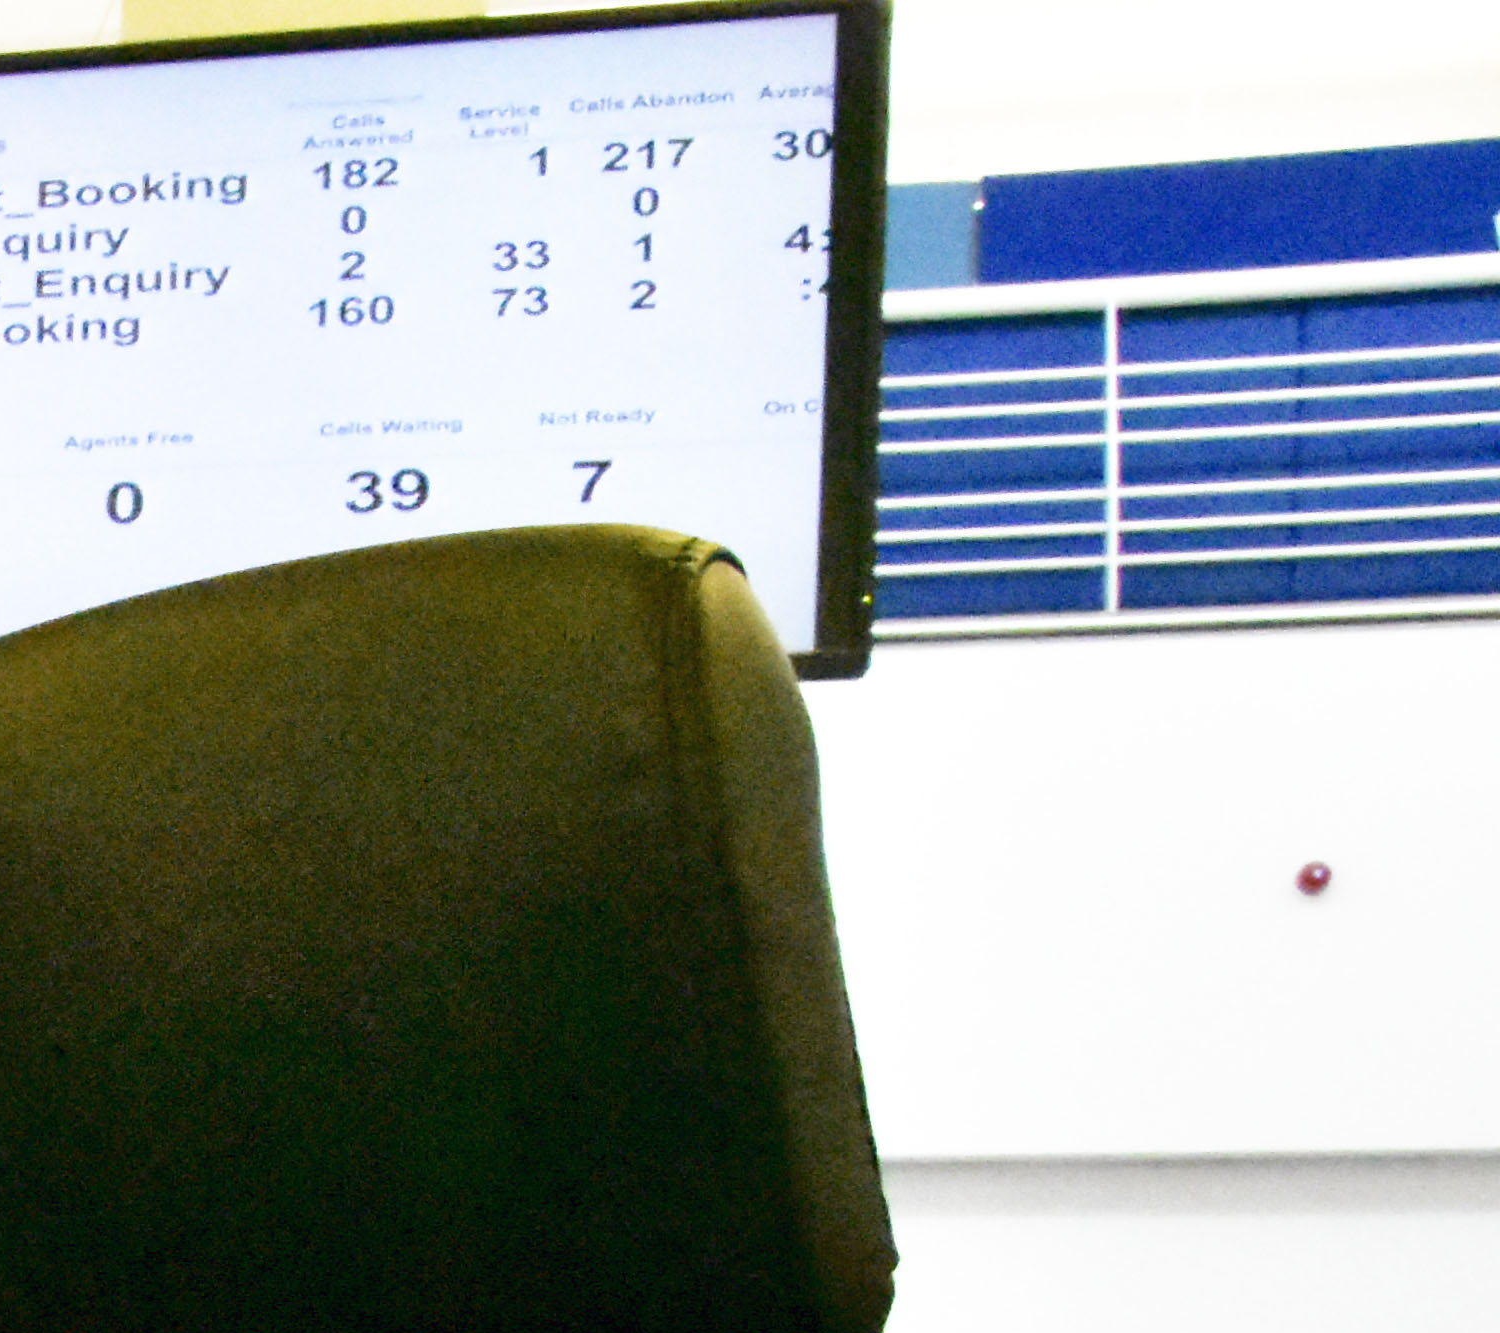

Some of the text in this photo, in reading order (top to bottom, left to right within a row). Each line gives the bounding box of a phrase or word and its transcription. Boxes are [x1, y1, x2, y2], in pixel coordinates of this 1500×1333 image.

[459, 102, 541, 122] Service
[569, 88, 735, 114] Calls Abandon
[469, 123, 530, 141] Level
[314, 157, 400, 191] 182
[530, 146, 551, 177] 1
[602, 137, 696, 174] 217
[340, 204, 367, 236] 0
[632, 186, 660, 218] 0
[340, 249, 367, 282] 2
[492, 240, 551, 273] 33
[633, 233, 654, 264] 1
[307, 295, 396, 328] 160
[492, 286, 551, 318] 73
[629, 279, 658, 312] 2
[380, 415, 465, 437] Waiting
[538, 404, 657, 428] Not Ready
[104, 480, 145, 526] 0
[344, 467, 432, 515] 39
[573, 457, 614, 506] 7
